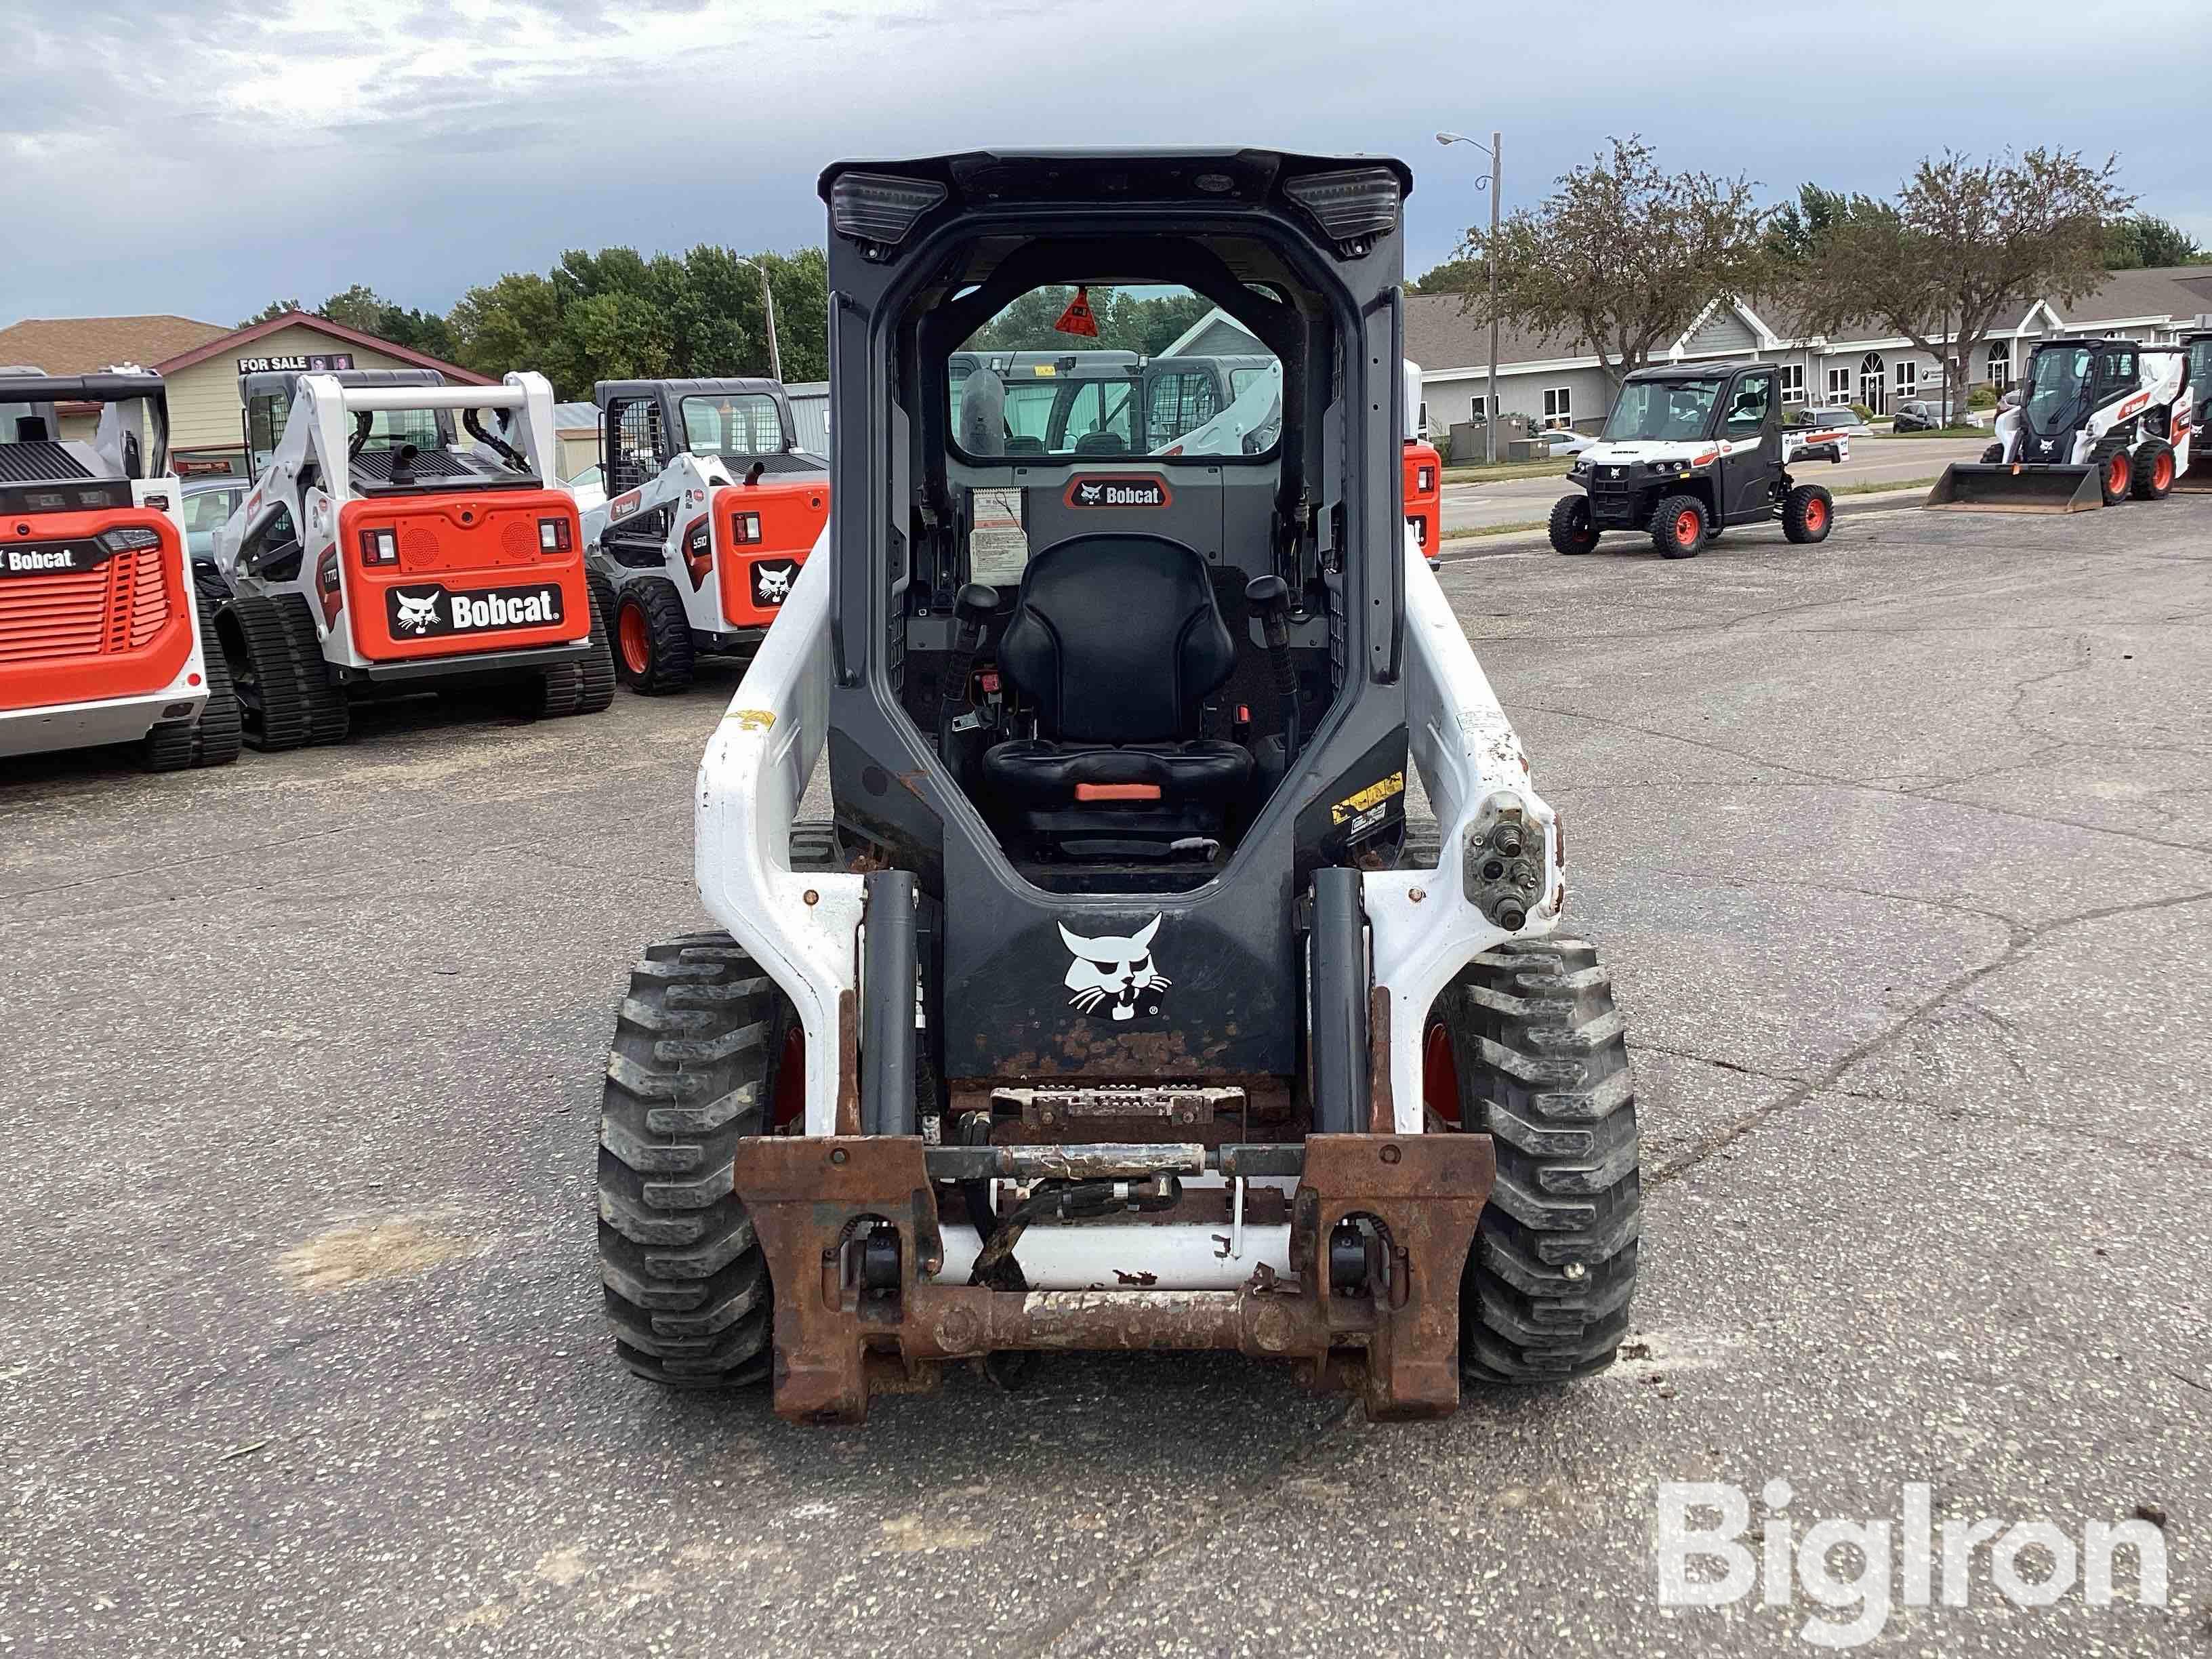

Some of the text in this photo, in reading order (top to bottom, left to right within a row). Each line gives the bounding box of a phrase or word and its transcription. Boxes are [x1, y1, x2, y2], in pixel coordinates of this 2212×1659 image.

[239, 357, 306, 371] FOR SALE
[1106, 487, 1159, 504] Bobcat
[8, 550, 72, 571] Bobcat
[451, 591, 553, 629] Bobcat
